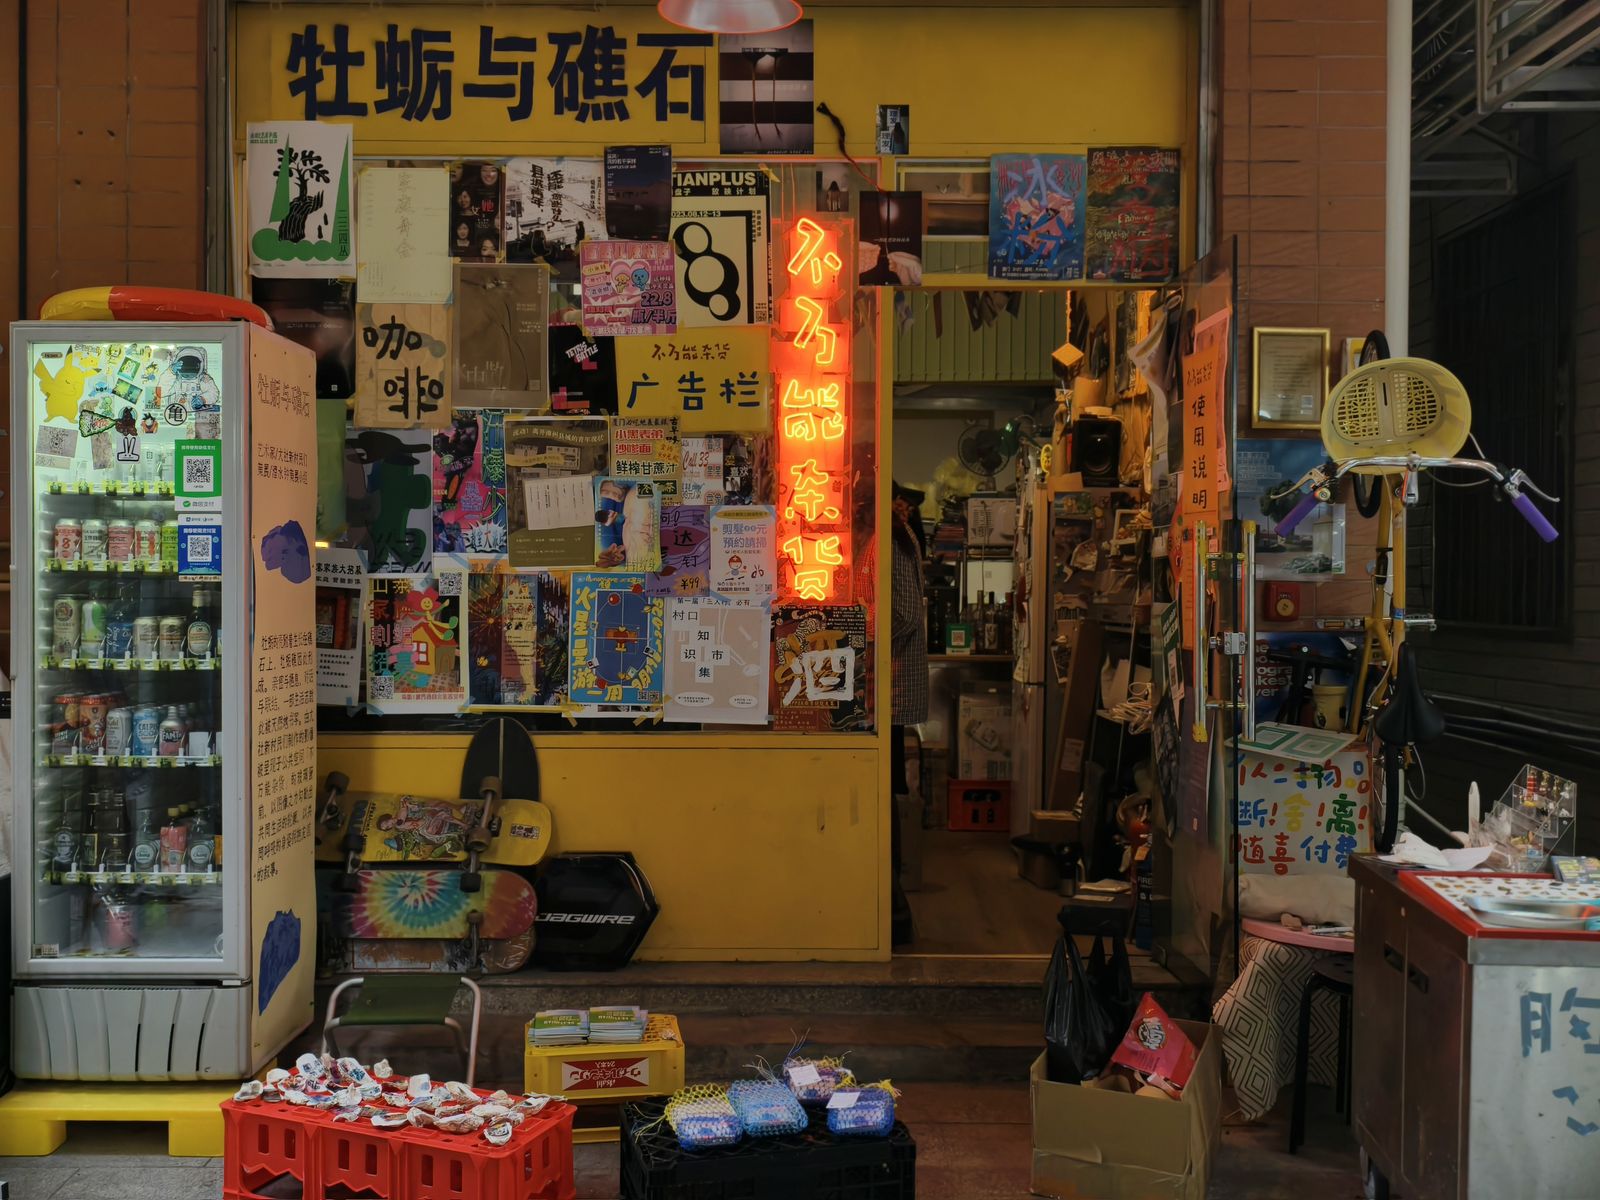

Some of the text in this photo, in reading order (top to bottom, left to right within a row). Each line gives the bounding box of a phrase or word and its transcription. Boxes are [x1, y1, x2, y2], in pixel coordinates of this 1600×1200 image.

[287, 25, 713, 121] 牡蛎与礁石
[641, 291, 673, 307] 22.8
[363, 315, 443, 420] 咖啡
[627, 371, 760, 410] 广告栏
[1192, 395, 1207, 509] 使用说明
[672, 610, 698, 621] 村口
[697, 630, 709, 641] 知
[684, 649, 724, 660] 识 市
[699, 667, 711, 678] 集
[535, 912, 636, 925] JAGWIRE
